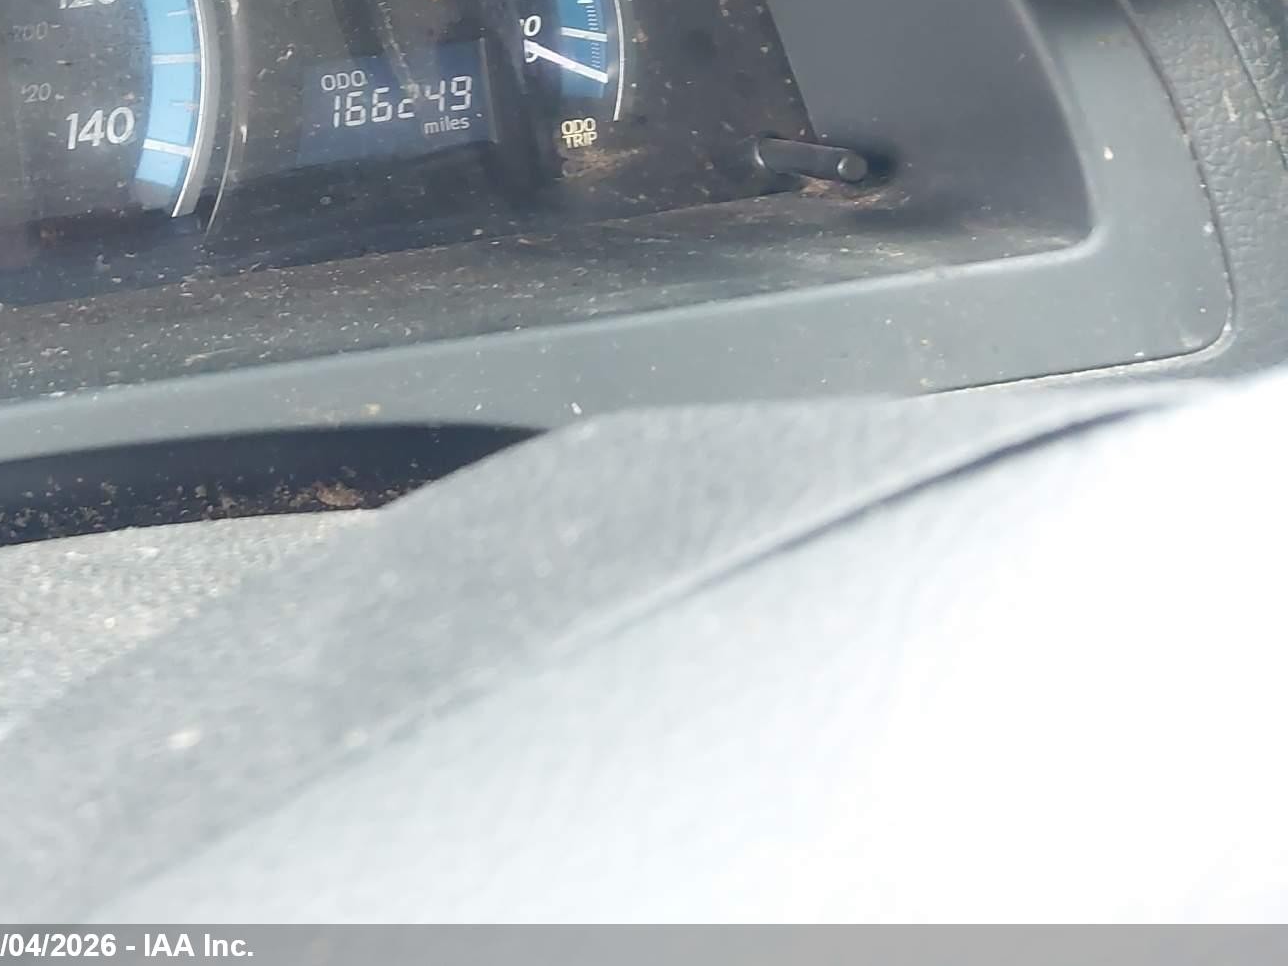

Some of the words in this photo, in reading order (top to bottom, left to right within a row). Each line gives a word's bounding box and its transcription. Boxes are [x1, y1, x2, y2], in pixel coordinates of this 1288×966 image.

[320, 70, 367, 91] ODO
[65, 106, 135, 150] 140
[423, 116, 471, 135] miles
[561, 117, 597, 135] ODO
[561, 131, 598, 149] TRIP
